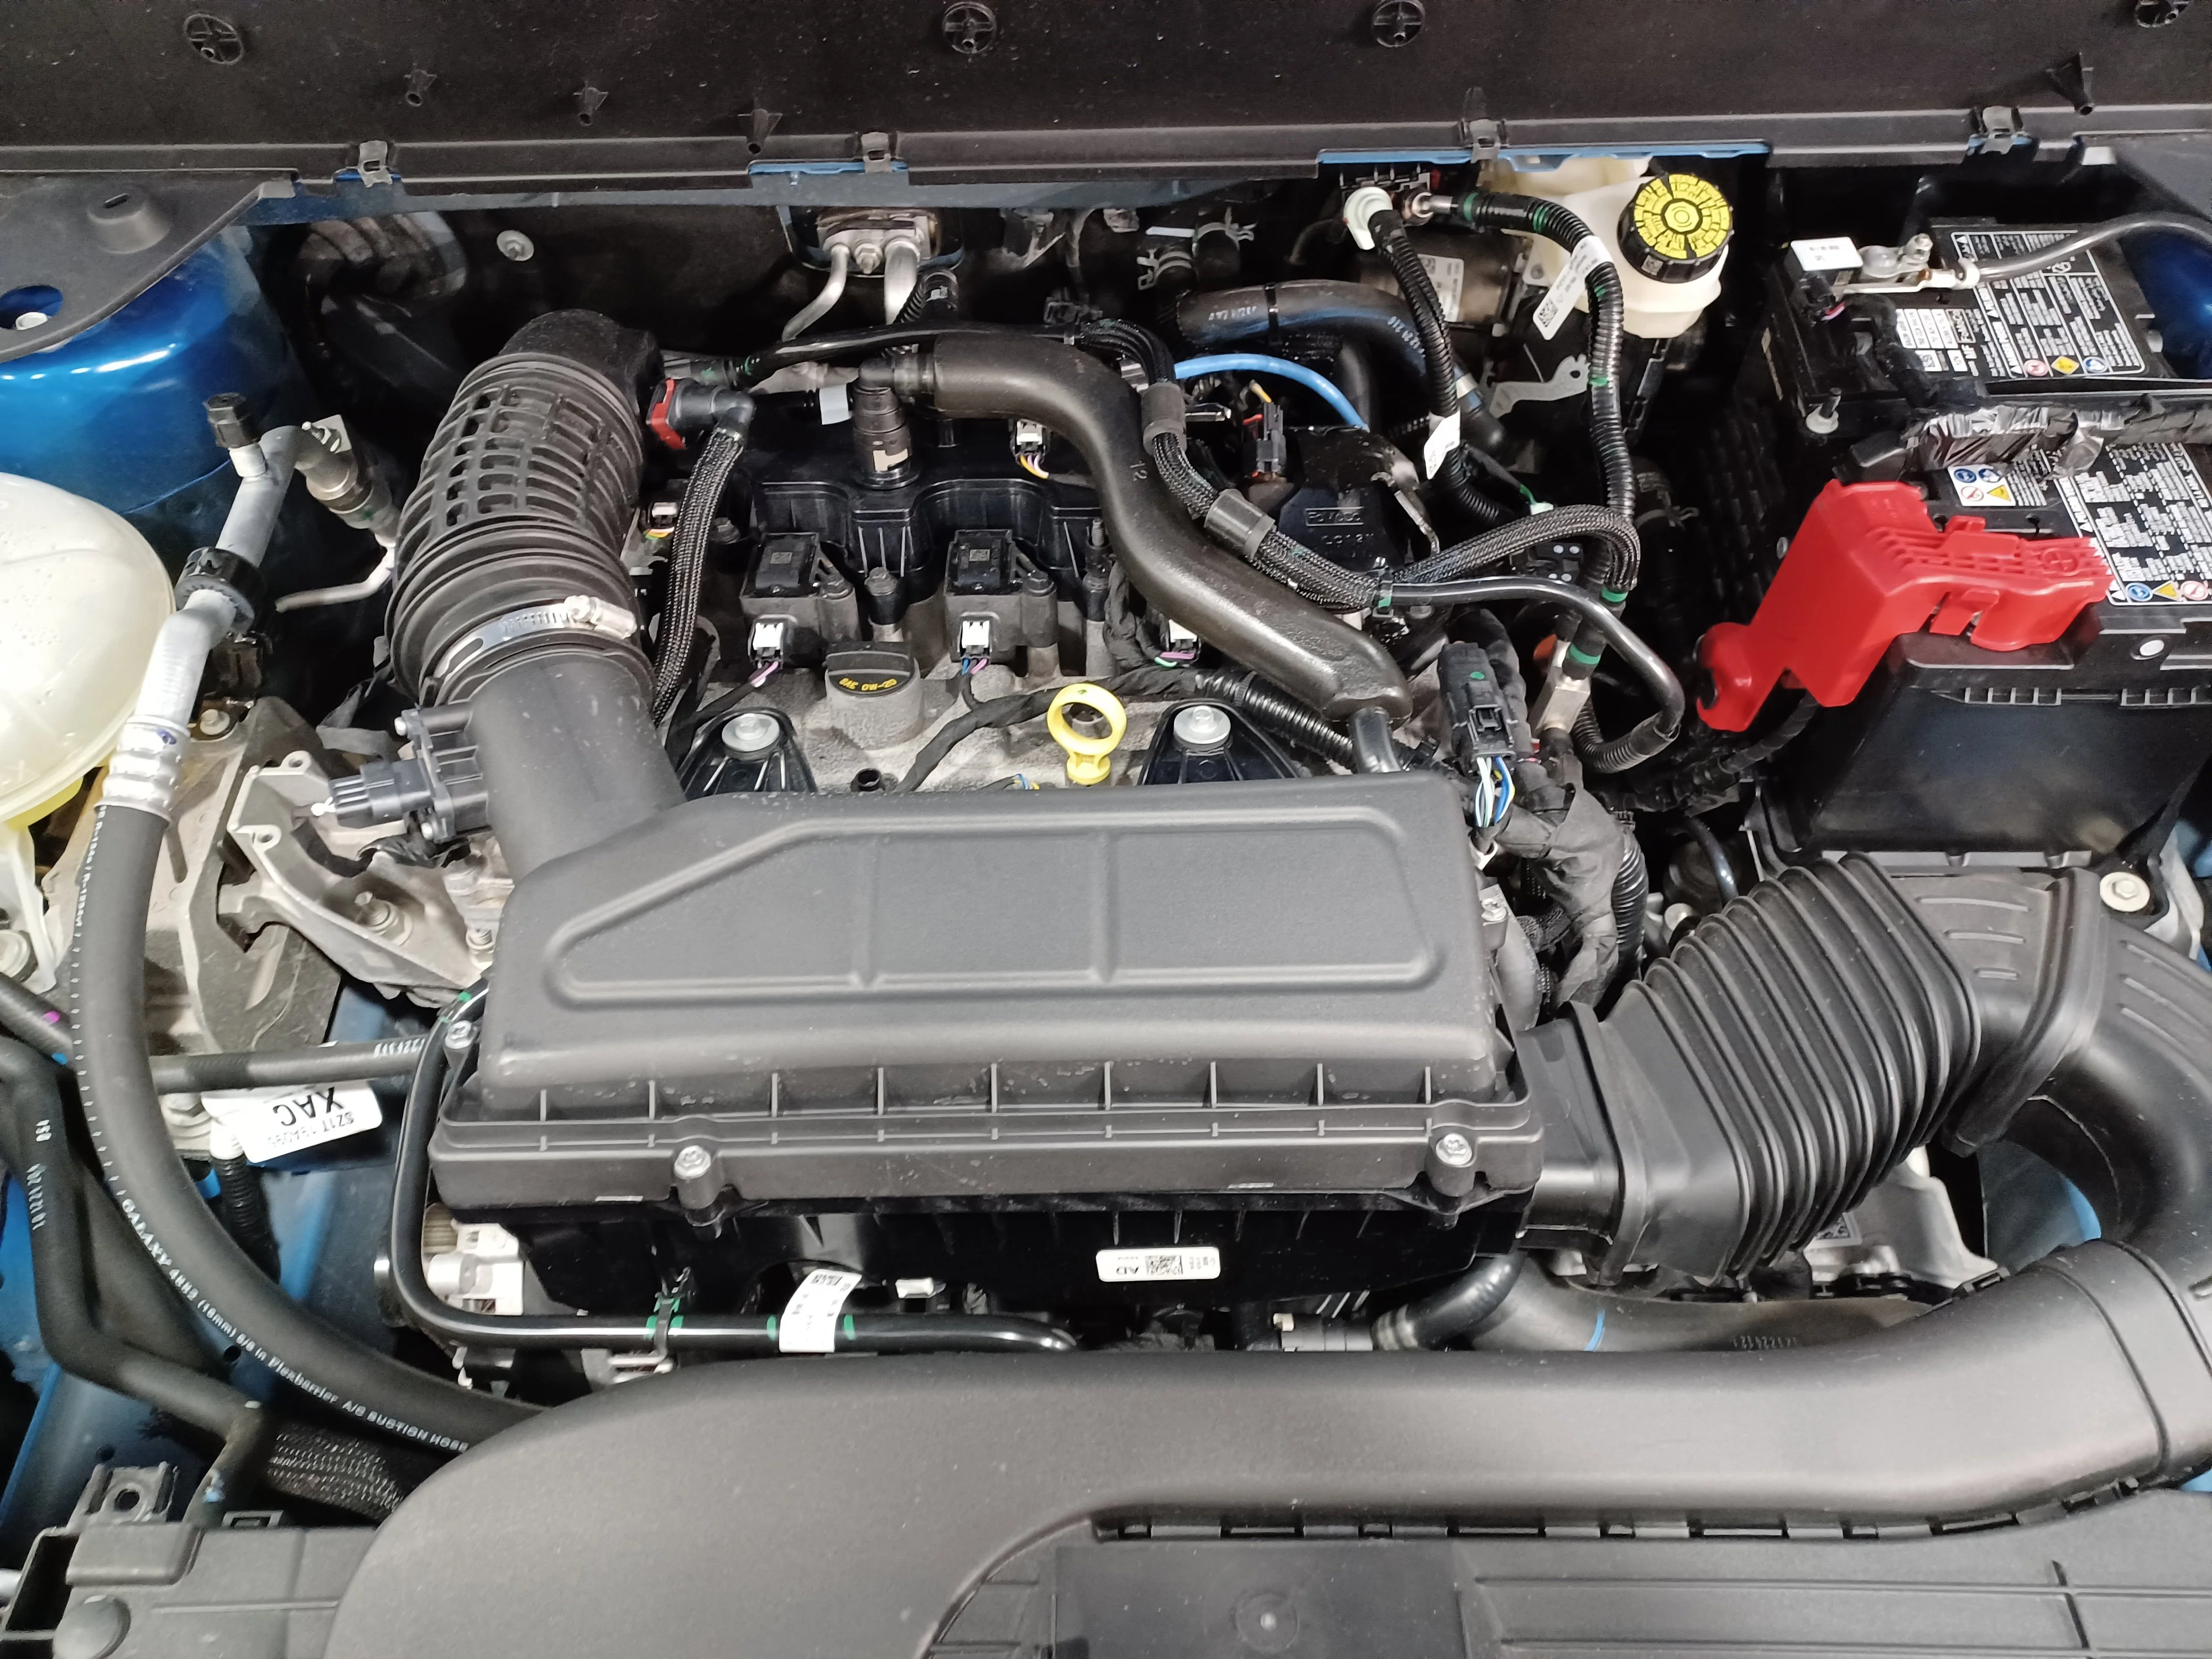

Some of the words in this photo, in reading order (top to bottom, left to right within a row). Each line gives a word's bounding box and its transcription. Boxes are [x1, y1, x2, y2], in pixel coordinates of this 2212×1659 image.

[1130, 461, 1146, 481] 12
[839, 678, 858, 689] SAE
[273, 1087, 344, 1126] XAC
[367, 1411, 428, 1440] SUCTION
